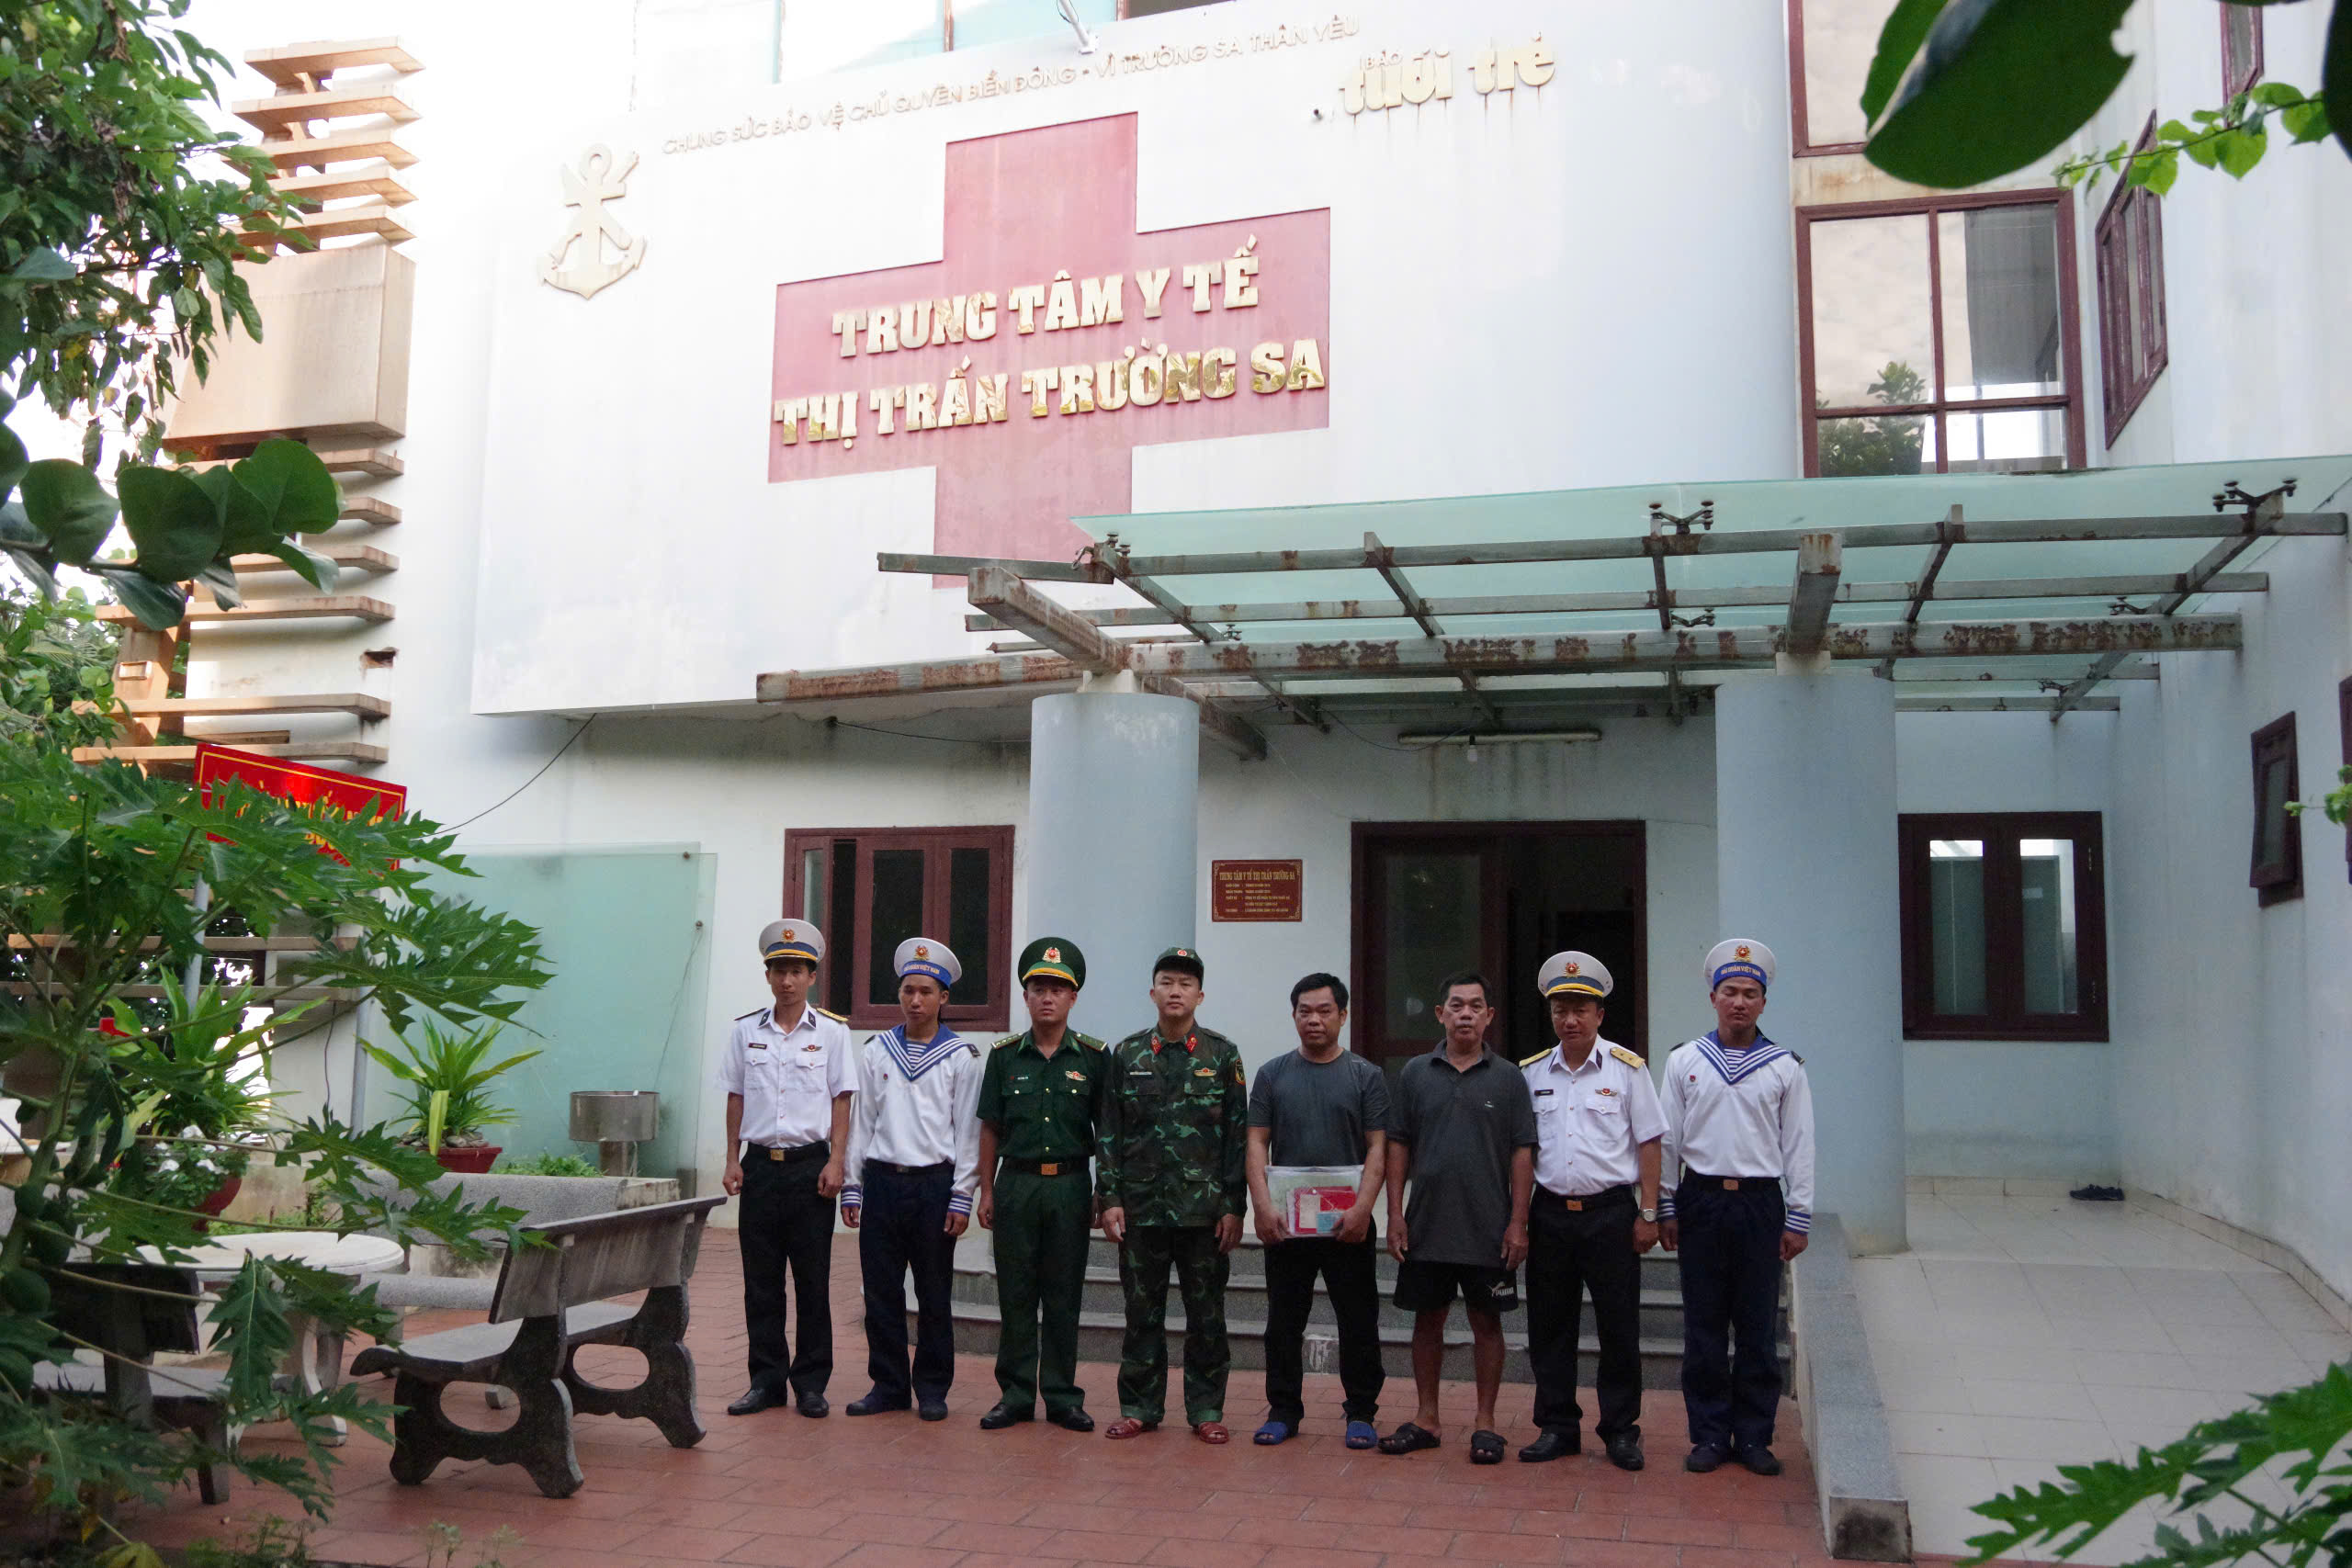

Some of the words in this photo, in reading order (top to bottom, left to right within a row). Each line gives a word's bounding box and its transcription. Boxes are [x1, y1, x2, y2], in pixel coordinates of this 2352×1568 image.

[662, 130, 728, 155] CHUNG
[1122, 44, 1208, 74] TRƯỜNG
[1213, 35, 1243, 58] SA
[1250, 23, 1307, 51] THÂN
[1314, 14, 1360, 42] YÊU
[1339, 49, 1453, 115] tuổi
[1468, 31, 1555, 95] trẻ
[832, 291, 997, 357] TRUNG
[1009, 269, 1123, 334] TÂM
[1136, 267, 1170, 319] Y
[1182, 234, 1259, 312] TẾ
[774, 391, 858, 449] THỊ
[869, 355, 1008, 434] TRẤN
[1021, 337, 1236, 418] TRƯỜNG
[1250, 338, 1325, 394] SA
